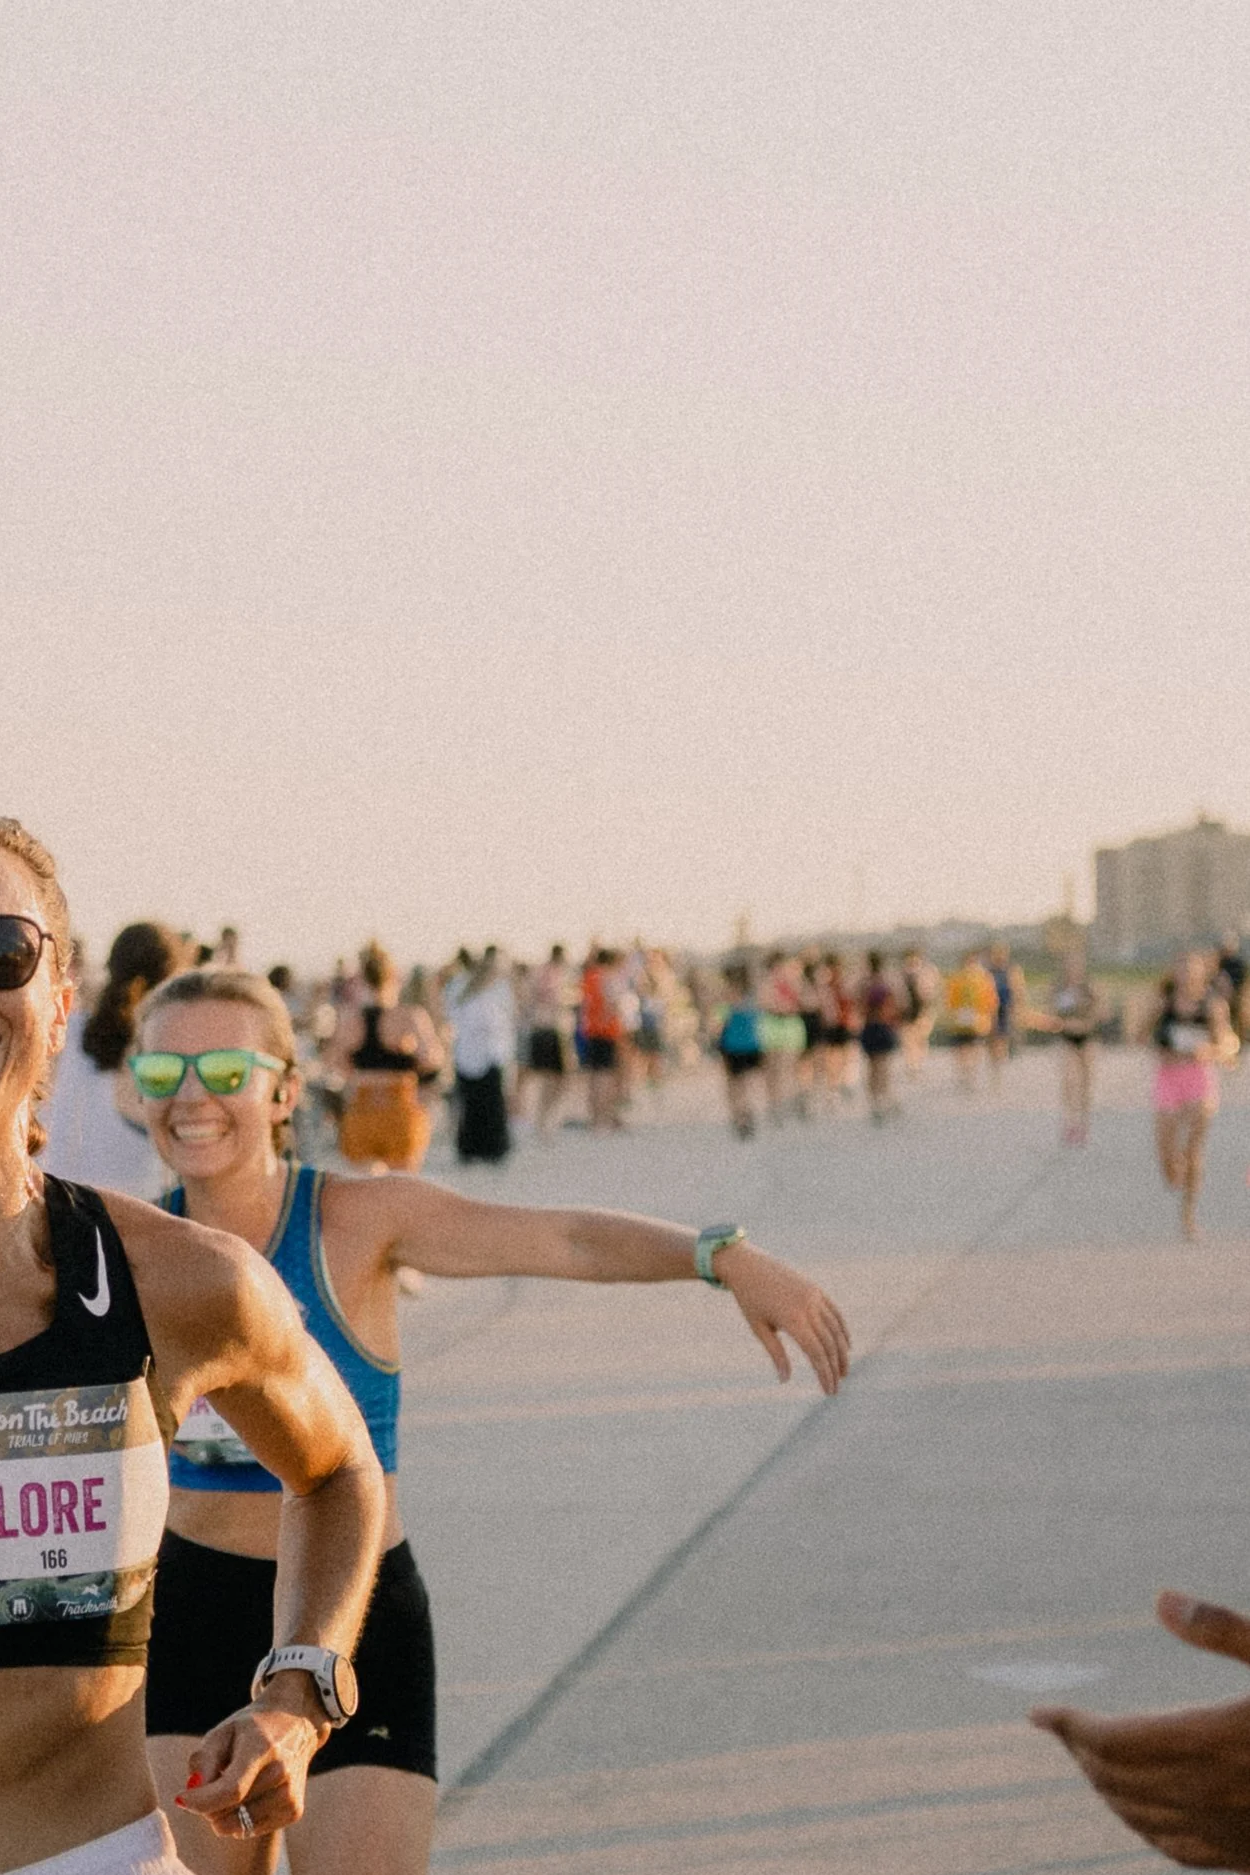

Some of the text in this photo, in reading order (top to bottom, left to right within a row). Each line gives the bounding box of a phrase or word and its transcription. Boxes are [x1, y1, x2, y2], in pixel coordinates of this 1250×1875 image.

[23, 1402, 62, 1431] The
[63, 1398, 128, 1427] Beach
[8, 1434, 45, 1449] TRIALS
[40, 1549, 68, 1570] 166
[56, 1595, 118, 1617] Tracksmith
